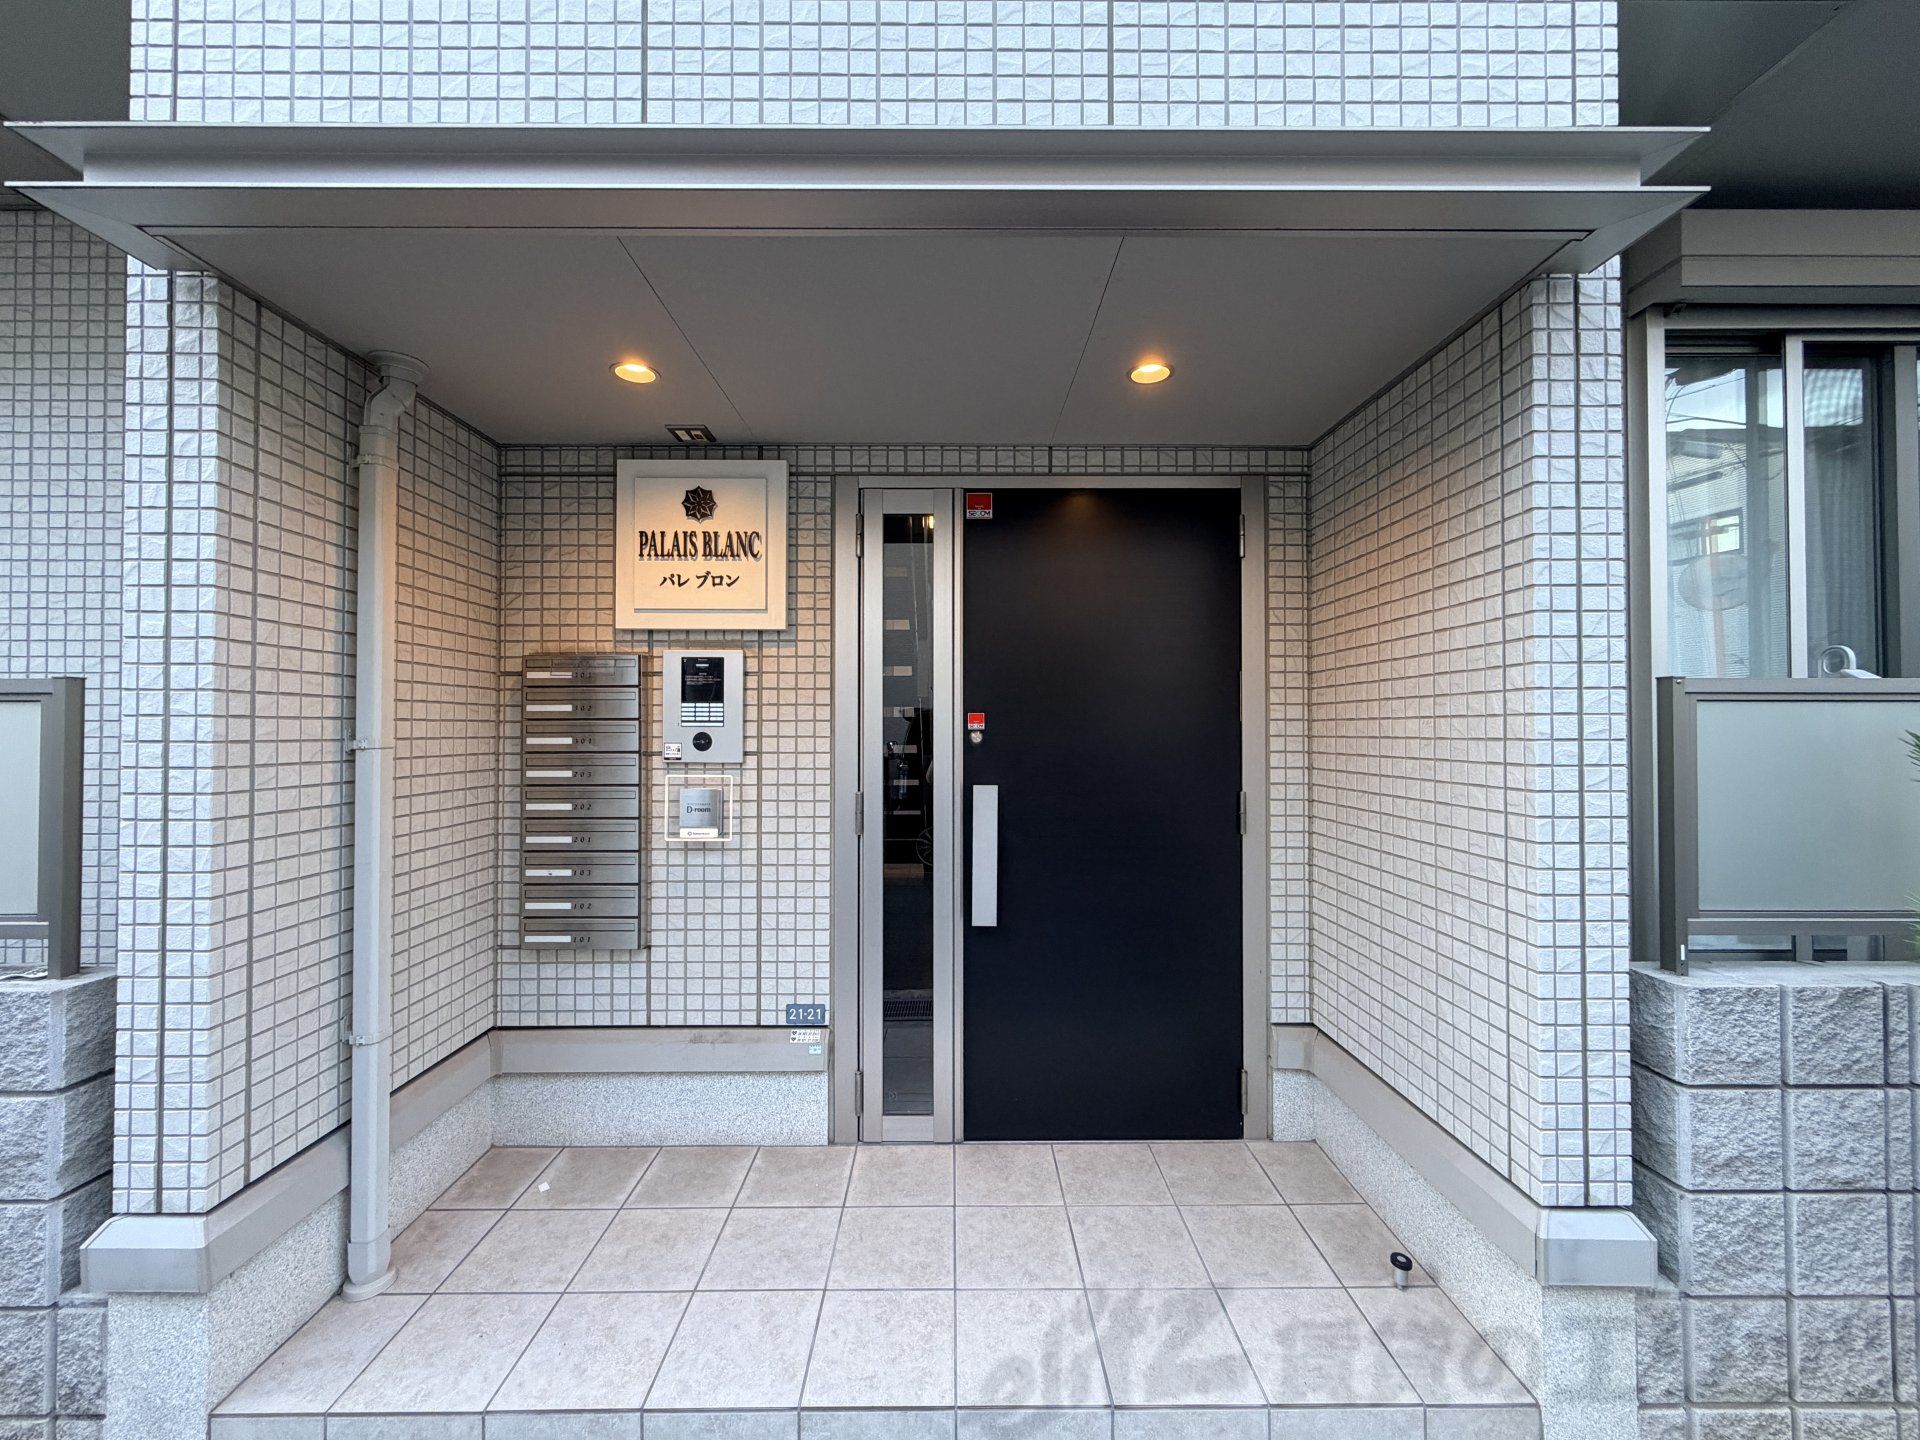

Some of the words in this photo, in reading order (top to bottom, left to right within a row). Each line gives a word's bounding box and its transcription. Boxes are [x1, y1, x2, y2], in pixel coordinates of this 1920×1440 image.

[638, 529, 698, 560] PALAIS
[702, 529, 761, 560] BLANC
[659, 573, 690, 588] パレ
[695, 570, 740, 589] ブロン
[573, 803, 592, 811] 202
[573, 869, 592, 877] 103
[573, 902, 592, 910] 102
[789, 1008, 821, 1020] 21-21
